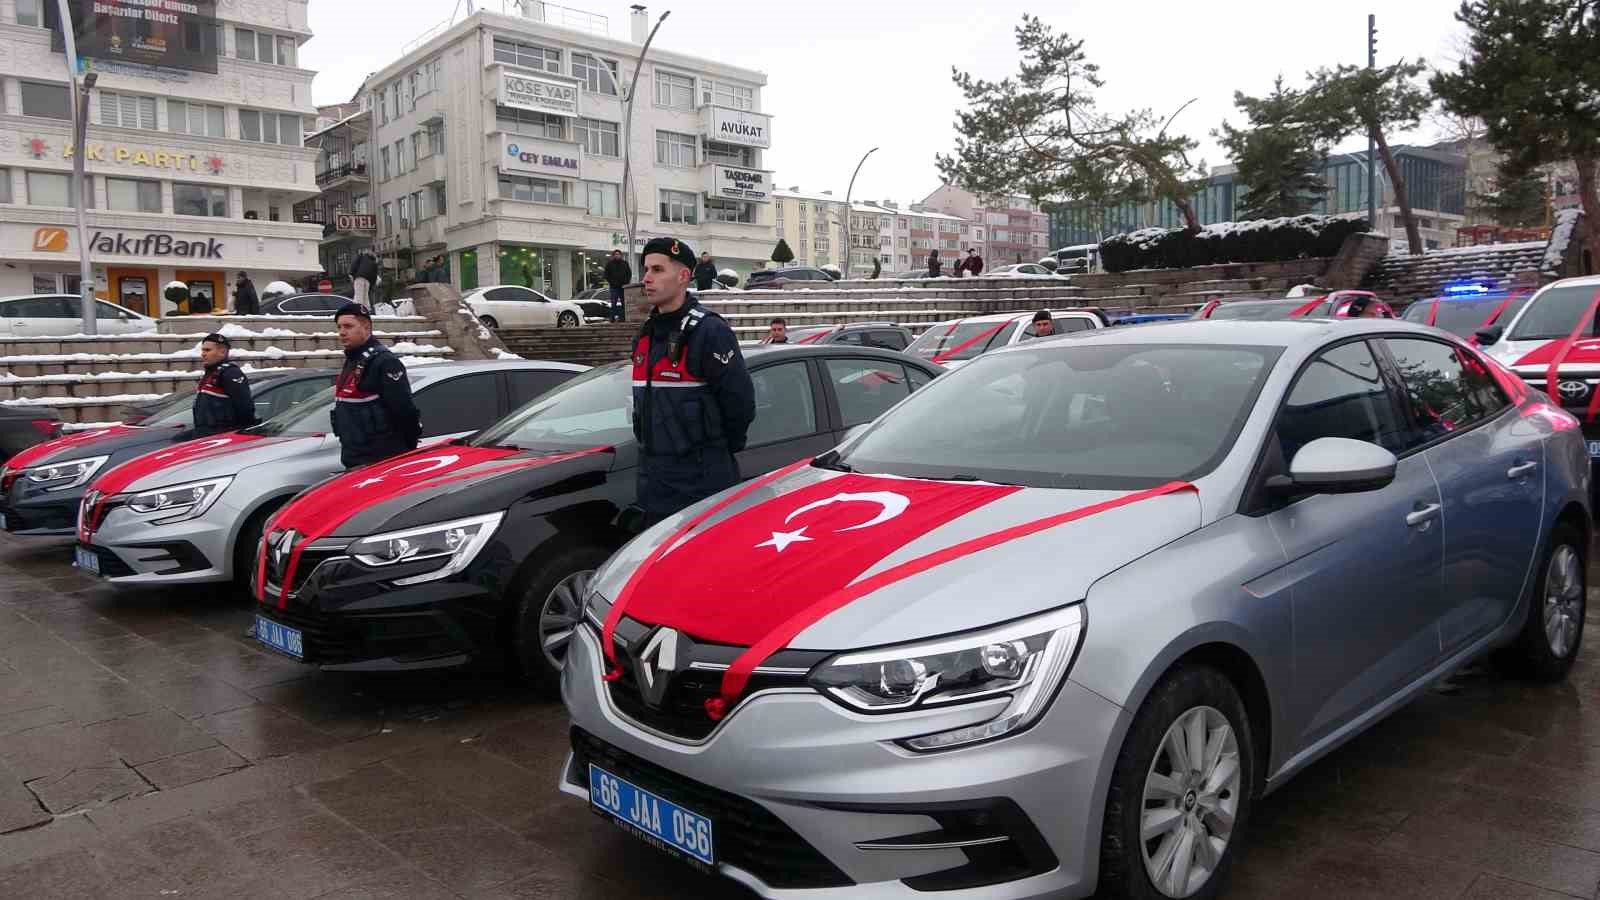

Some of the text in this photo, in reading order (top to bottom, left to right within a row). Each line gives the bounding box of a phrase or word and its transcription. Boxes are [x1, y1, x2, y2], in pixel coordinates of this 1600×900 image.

[144, 9, 179, 25] Dileriz
[721, 121, 763, 137] AVUKAT
[519, 152, 539, 164] CEY
[339, 215, 376, 228] OTEL
[600, 774, 620, 811] 66
[630, 790, 662, 834] JAA
[672, 809, 710, 856] 056
